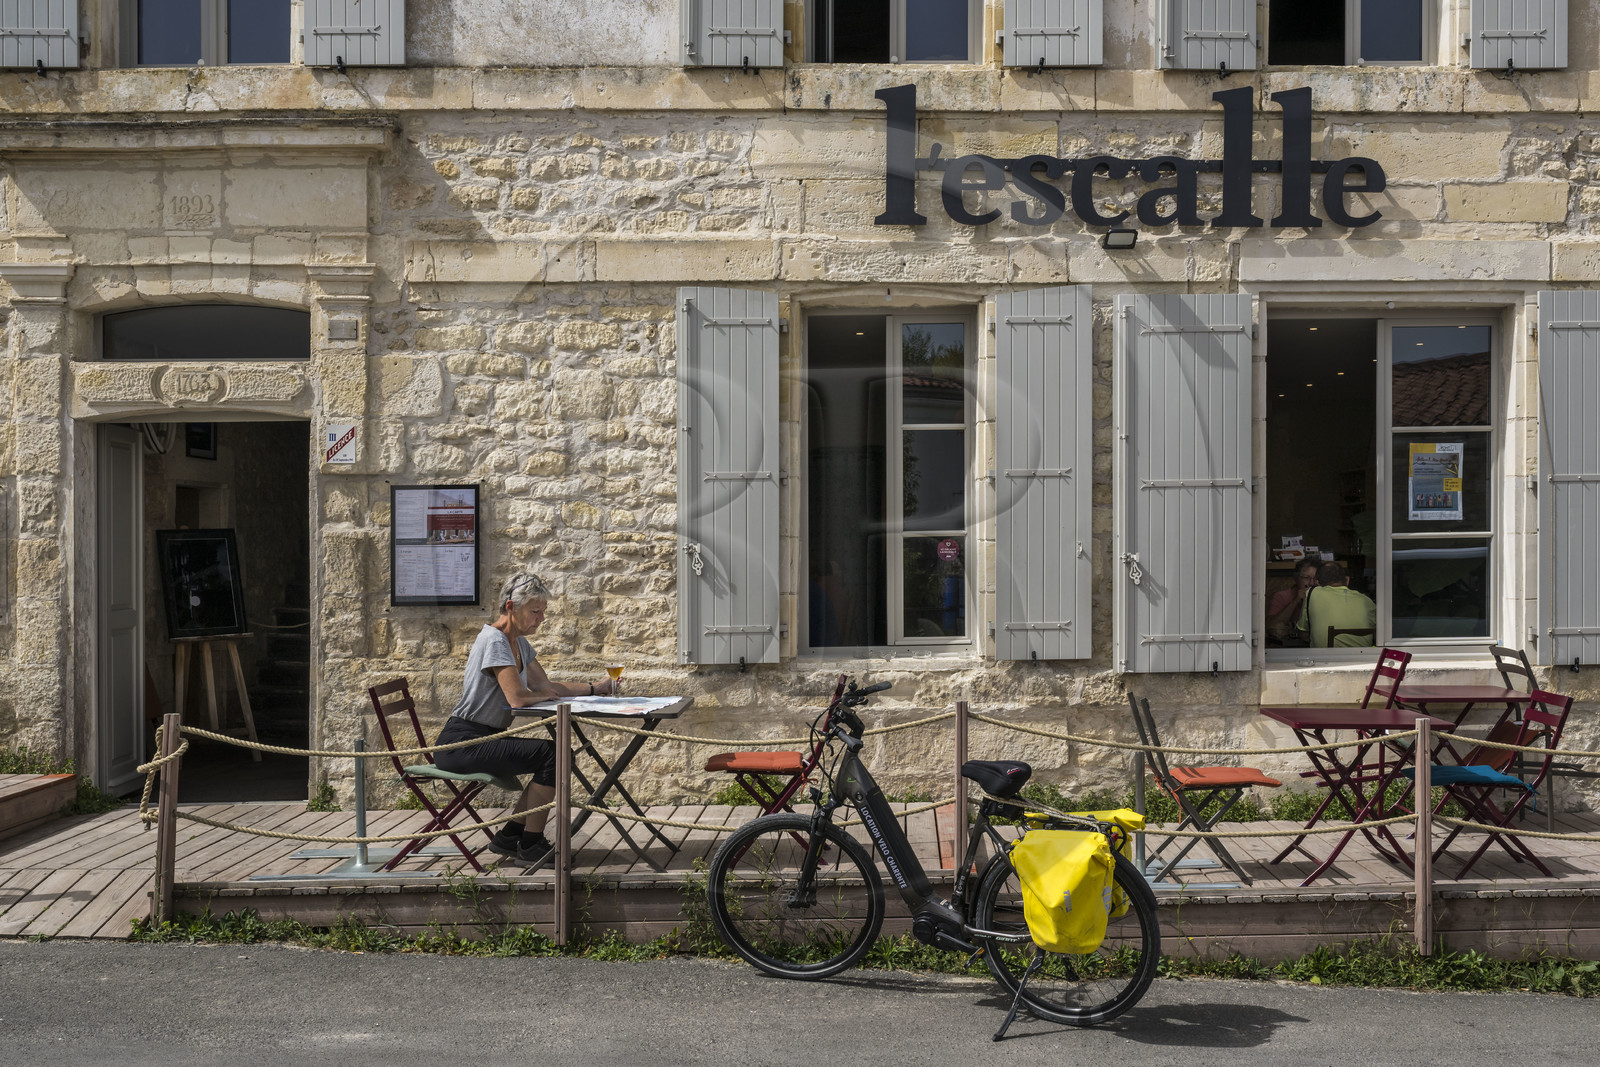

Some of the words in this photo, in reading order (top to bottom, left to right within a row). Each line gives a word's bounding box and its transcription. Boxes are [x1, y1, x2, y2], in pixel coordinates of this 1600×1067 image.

[874, 84, 1387, 229] l'escalle
[170, 194, 215, 215] 1893
[177, 373, 212, 395] 1763
[328, 430, 353, 459] LICENCE
[860, 806, 881, 839] LOCATION
[878, 838, 890, 856] VELO
[886, 856, 907, 889] CHARENTE
